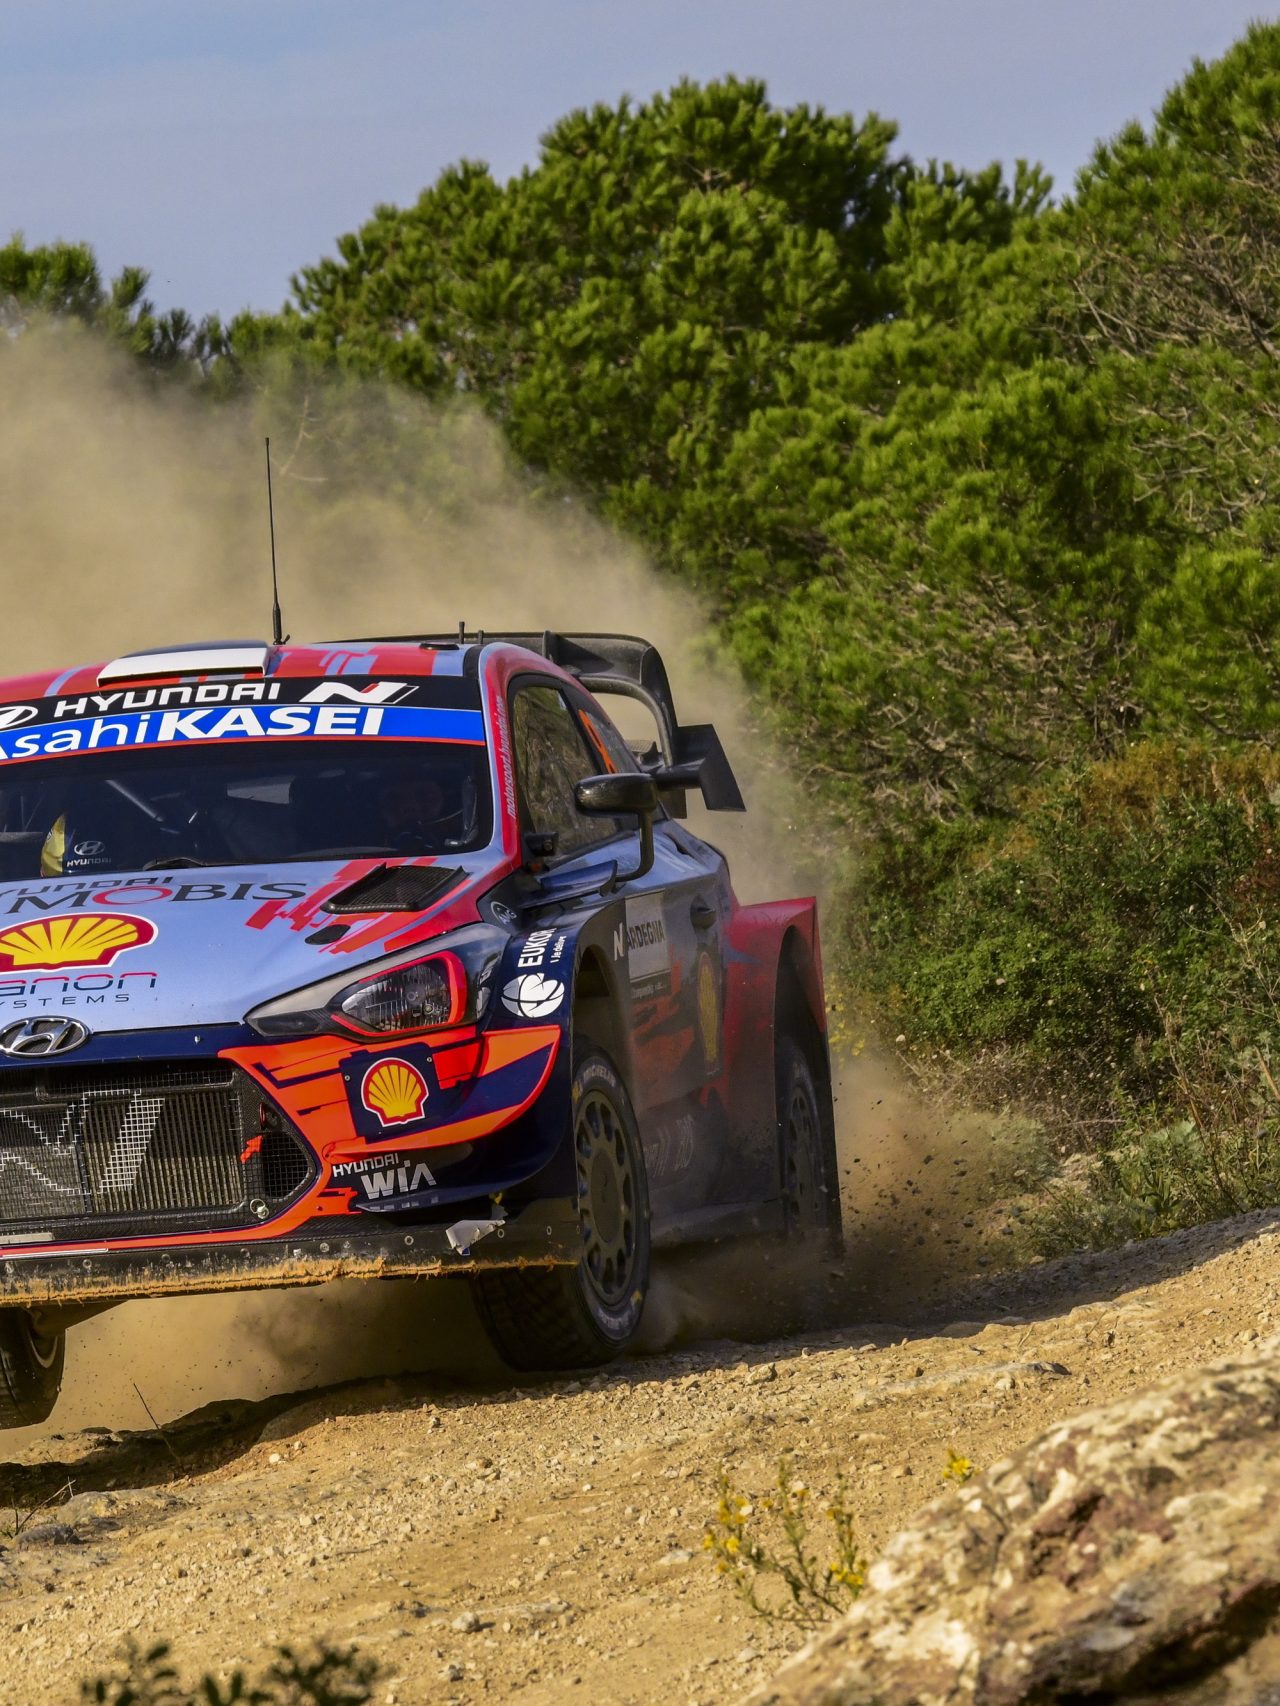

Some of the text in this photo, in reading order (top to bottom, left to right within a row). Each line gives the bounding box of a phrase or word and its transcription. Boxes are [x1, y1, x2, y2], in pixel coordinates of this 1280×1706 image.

[53, 682, 281, 717] HYUNDAI
[66, 858, 112, 868] HYUNDAI
[4, 882, 307, 914] MOBIS
[517, 928, 557, 968] EUKOR
[626, 920, 666, 951] ARDEGNA
[332, 1152, 400, 1178] HYUNDAI
